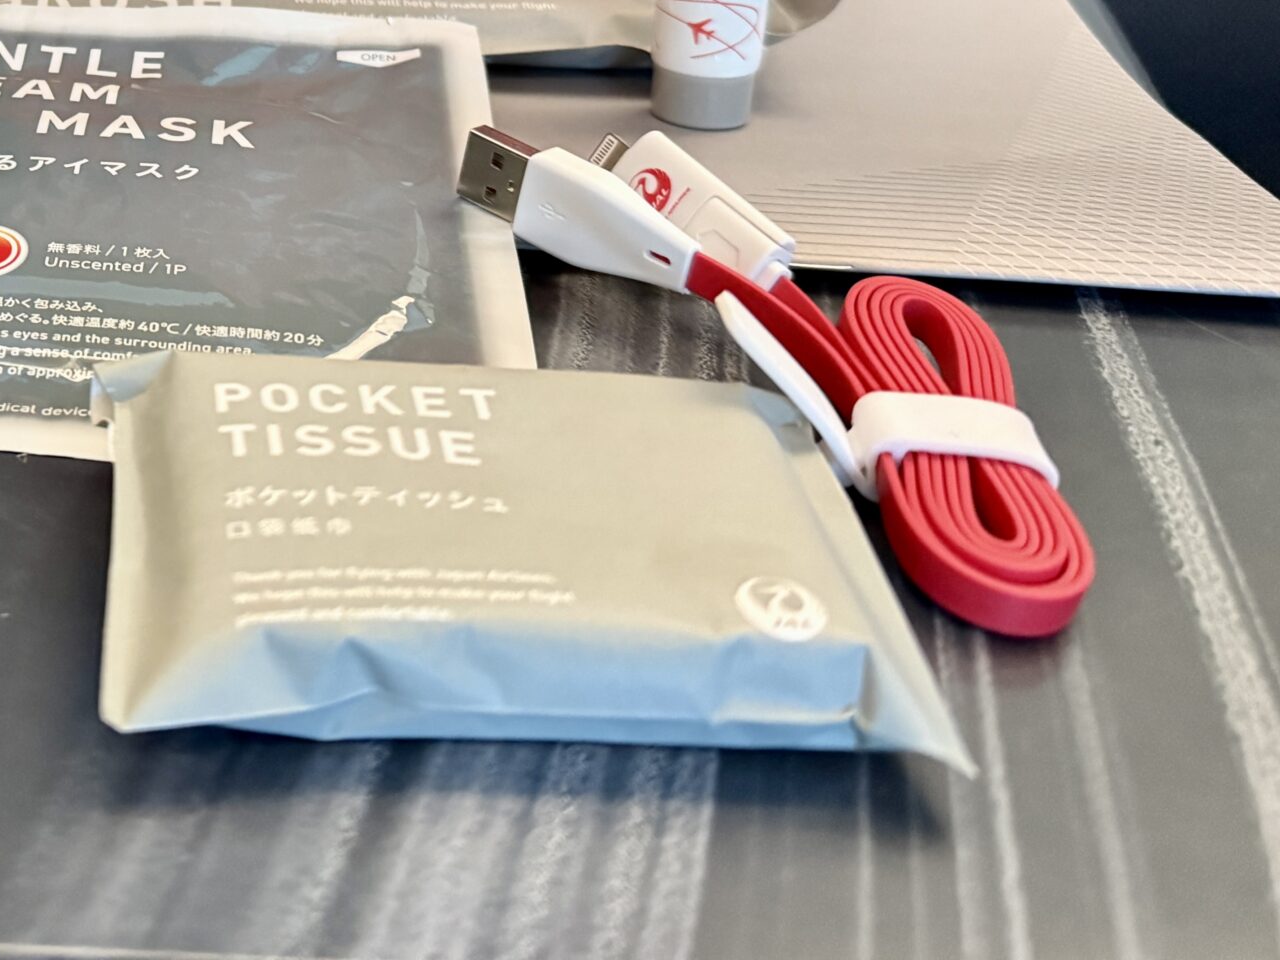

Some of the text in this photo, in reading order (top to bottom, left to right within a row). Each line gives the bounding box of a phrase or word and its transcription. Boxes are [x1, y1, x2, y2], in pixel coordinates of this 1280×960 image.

[360, 53, 396, 62] OPEN
[35, 109, 255, 149] MASK
[44, 256, 144, 274] Unscented
[165, 263, 187, 275] 1P
[13, 330, 48, 340] eyes
[52, 329, 81, 343] and
[85, 334, 110, 344] the
[114, 337, 211, 353] surrounding
[10, 348, 20, 357] a
[23, 347, 72, 358] sense
[74, 348, 90, 359] of
[7, 365, 24, 376] of
[214, 382, 497, 420] POCKET
[217, 423, 483, 466] TISSUE
